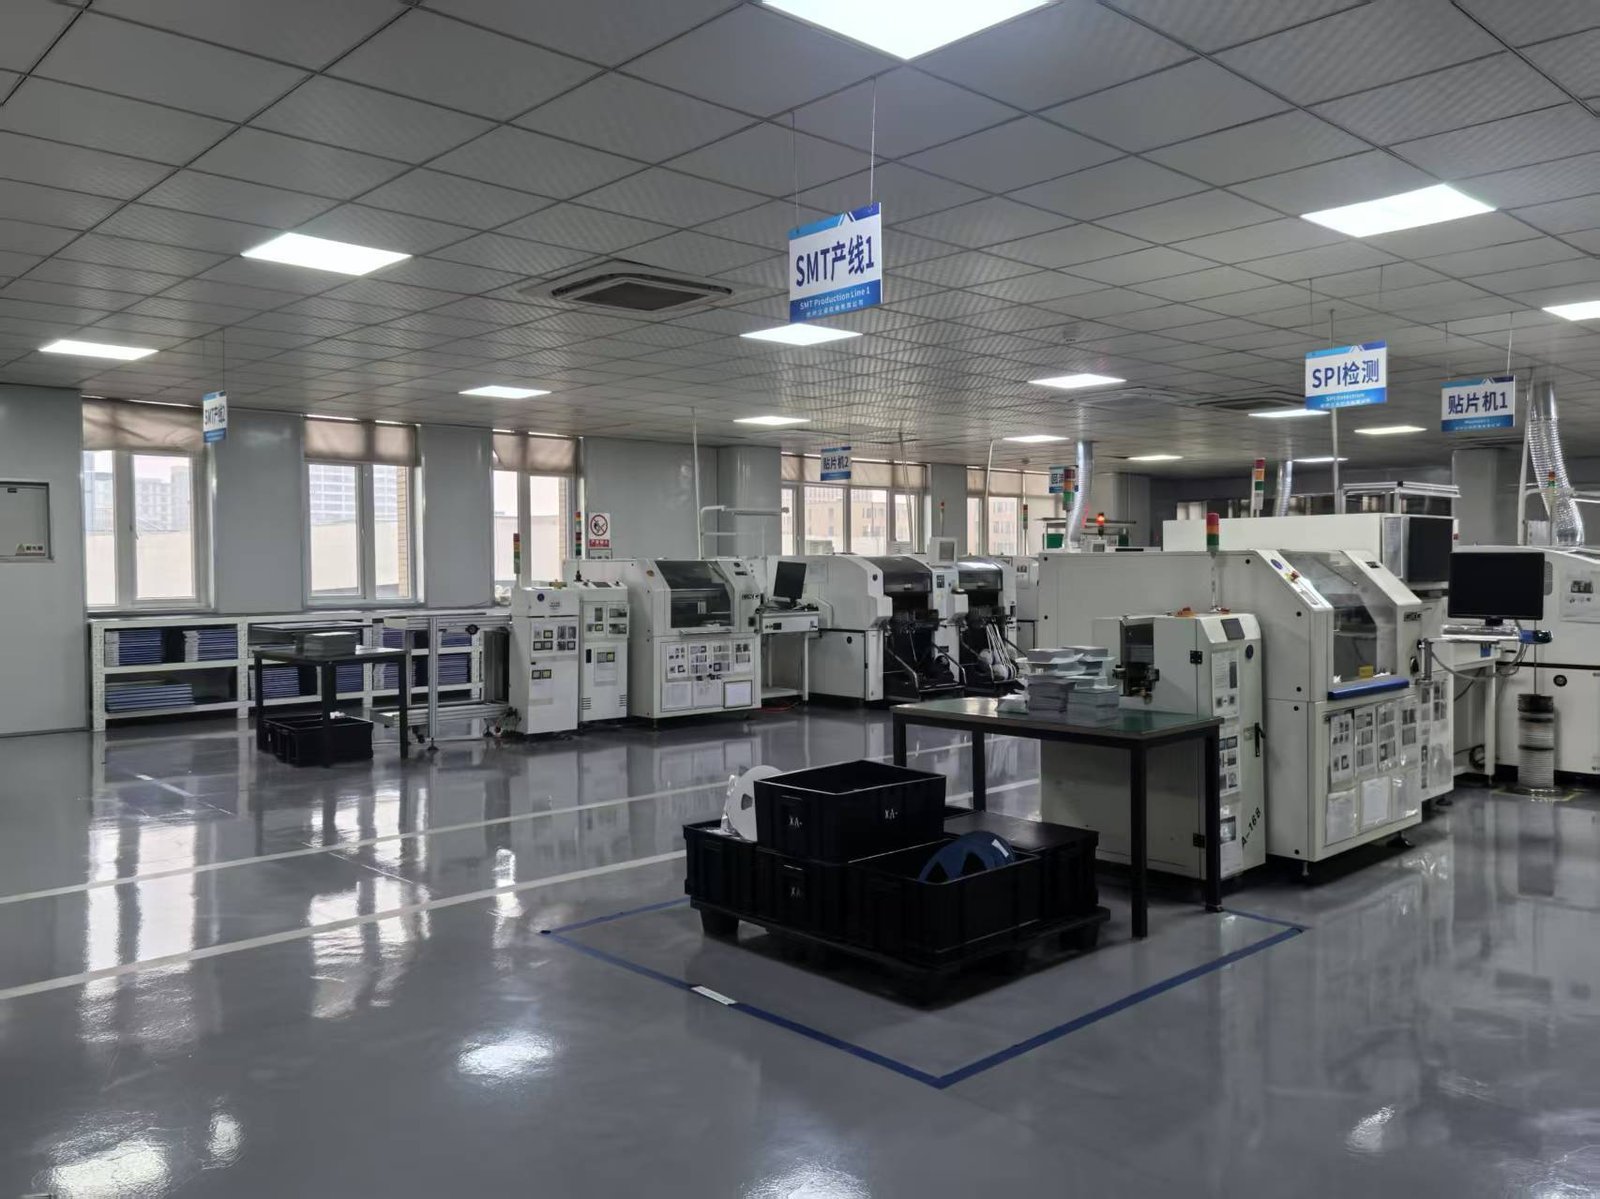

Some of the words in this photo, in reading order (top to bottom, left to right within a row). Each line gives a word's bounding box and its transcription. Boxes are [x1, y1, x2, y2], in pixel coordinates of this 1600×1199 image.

[796, 234, 874, 287] SMT产线1
[800, 300, 813, 310] SMT
[814, 292, 850, 306] Production
[850, 288, 865, 298] Line
[1312, 358, 1379, 388] SPI检测
[1448, 391, 1508, 415] 贴片机1
[823, 455, 848, 469] 贴片机2
[1241, 807, 1261, 849] A-168
